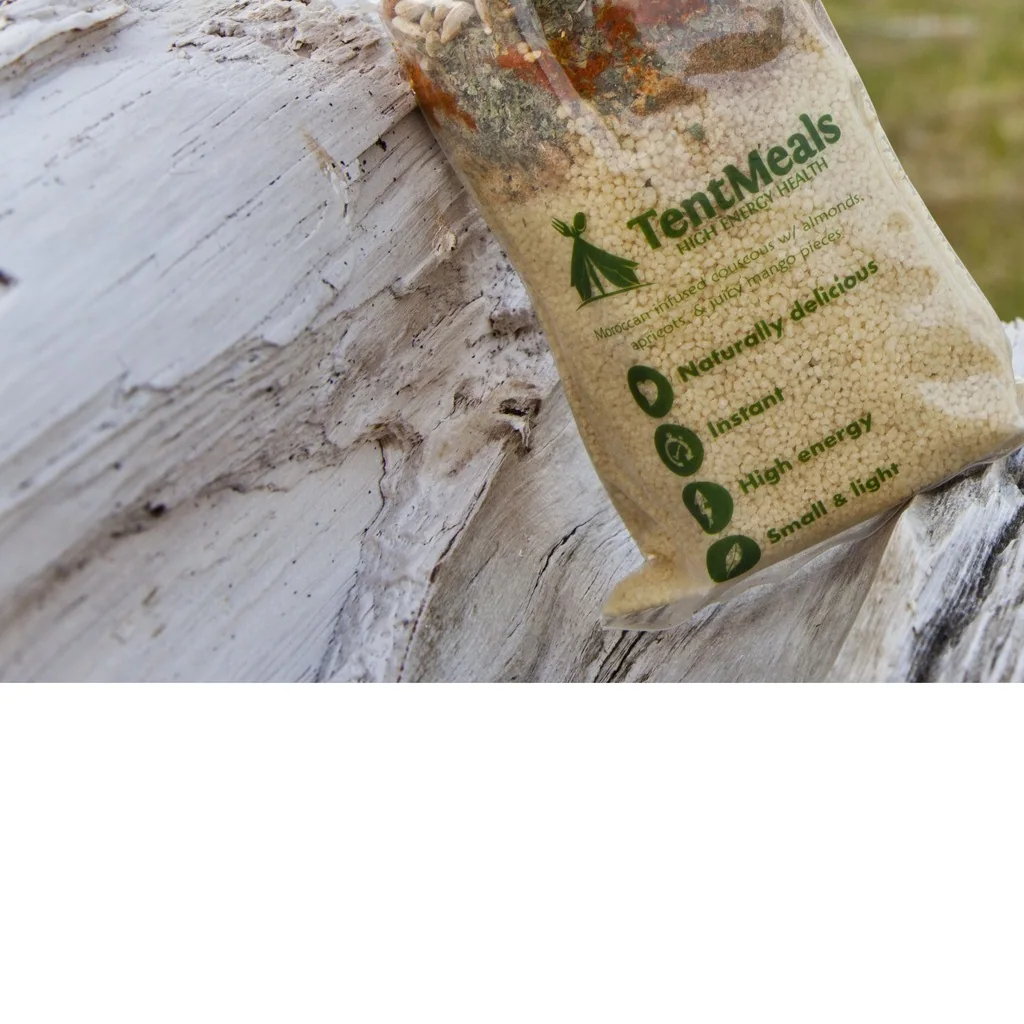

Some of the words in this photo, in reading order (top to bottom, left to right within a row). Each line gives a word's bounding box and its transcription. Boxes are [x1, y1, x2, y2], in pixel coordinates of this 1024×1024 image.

[626, 113, 841, 250] TentMeals
[675, 226, 717, 255] HIGH
[720, 191, 775, 230] ENERGY
[776, 157, 829, 197] HEALTH
[594, 311, 651, 342] Moroccan
[653, 278, 706, 314] infused
[711, 242, 775, 282] couscous
[778, 225, 796, 245] w/
[676, 317, 784, 383] Naturally
[789, 259, 879, 321] delicious
[694, 304, 707, 318] &
[709, 283, 742, 313] juicy
[748, 254, 797, 287] mango
[707, 387, 785, 438] Instant
[737, 458, 793, 495] High
[797, 411, 873, 462] energy
[766, 500, 828, 544] Small
[833, 493, 847, 507] &
[850, 462, 900, 497] light
